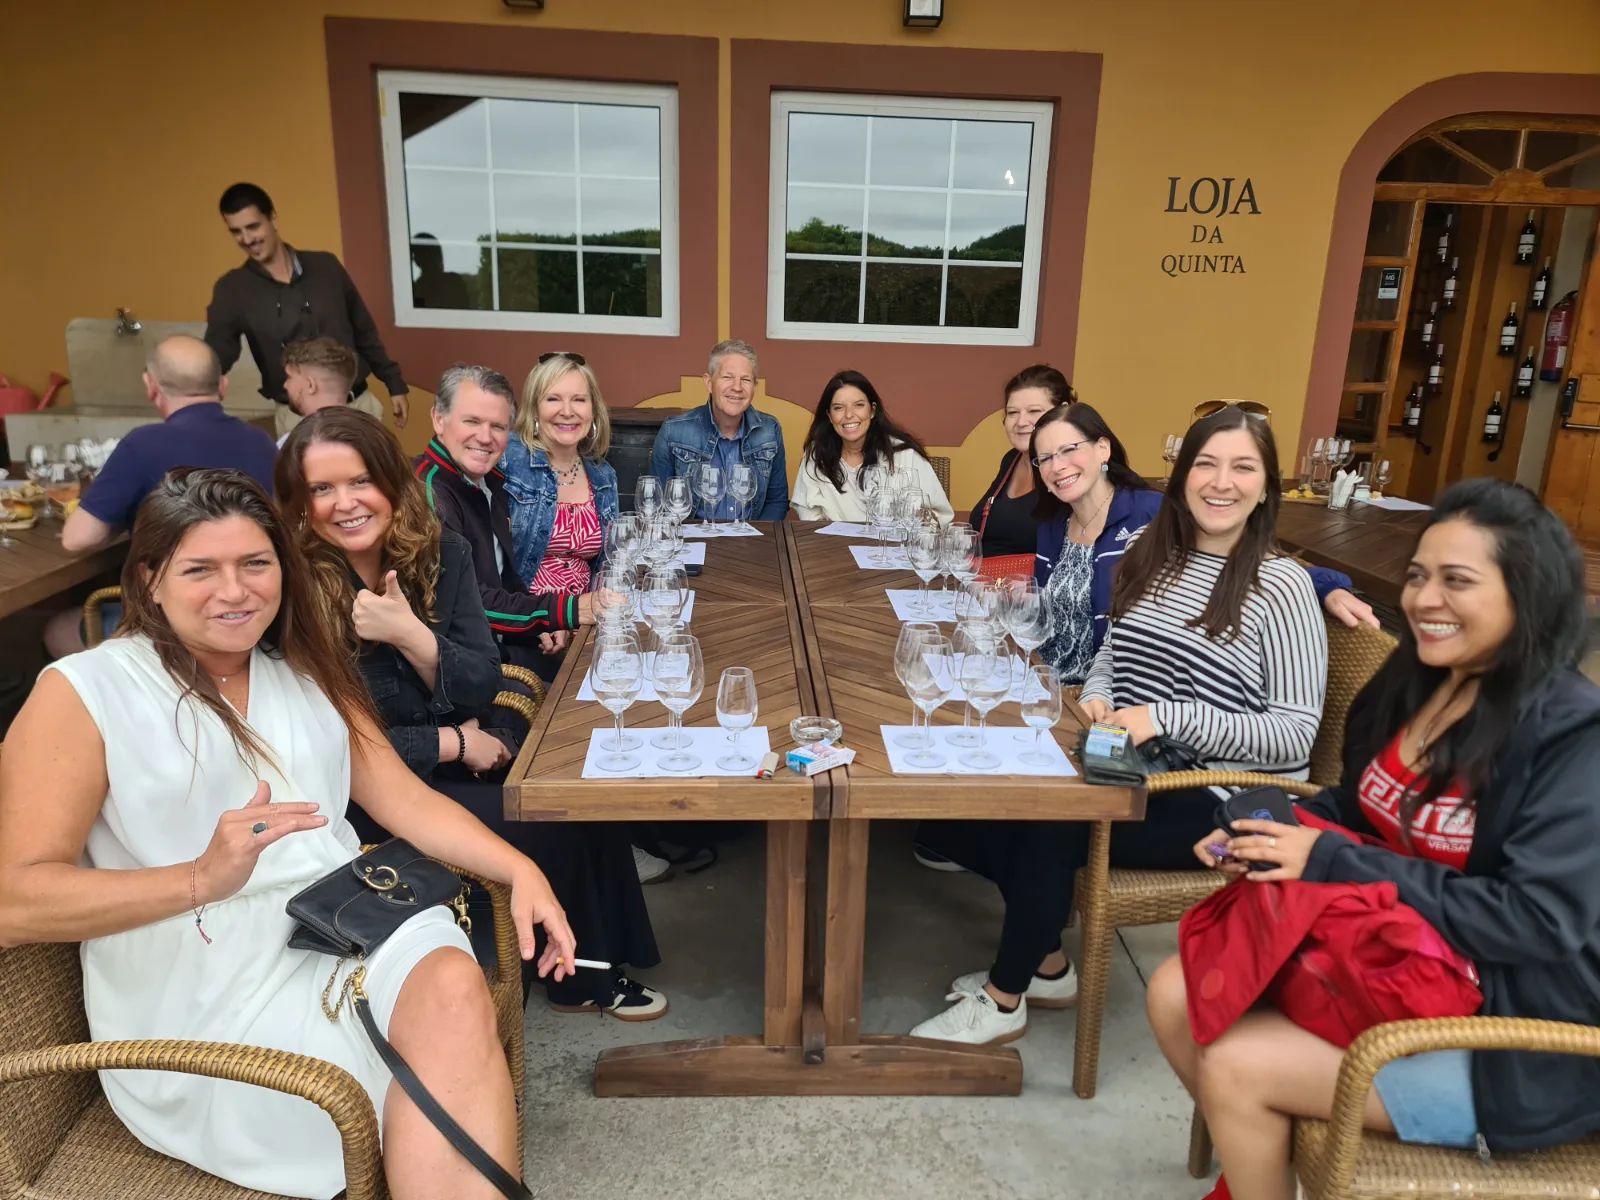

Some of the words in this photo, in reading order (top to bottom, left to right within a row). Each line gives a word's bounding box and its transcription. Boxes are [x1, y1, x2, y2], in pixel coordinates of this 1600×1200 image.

[1164, 176, 1262, 218] LOJA
[1191, 224, 1224, 244] DA
[1161, 254, 1247, 278] QUINTA
